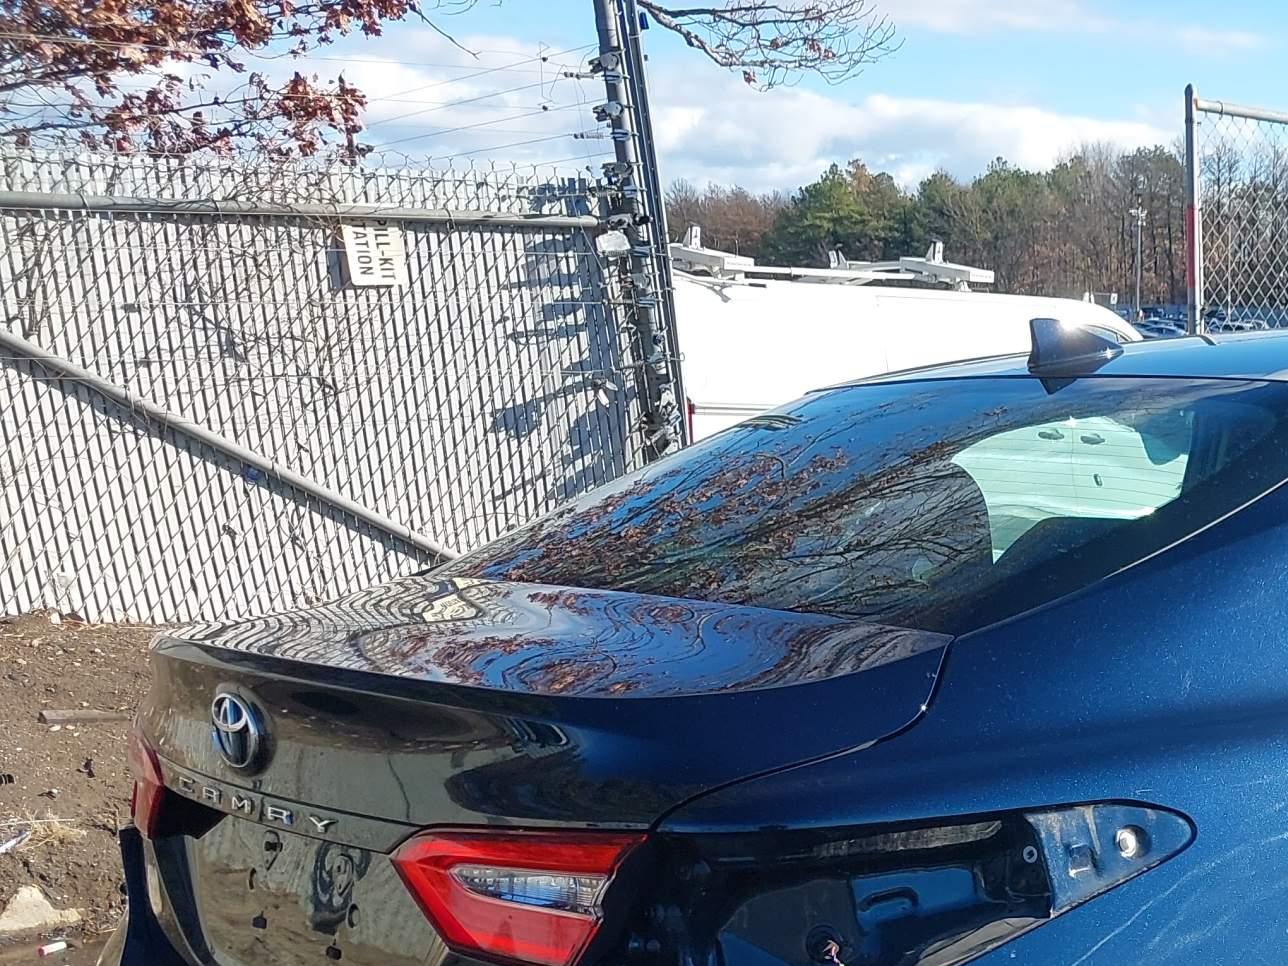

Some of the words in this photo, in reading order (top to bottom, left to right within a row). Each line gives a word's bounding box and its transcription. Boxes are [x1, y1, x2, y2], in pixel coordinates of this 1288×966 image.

[351, 220, 375, 276] TATION
[373, 219, 397, 281] PILL-KIT
[178, 776, 339, 833] CAMRY
